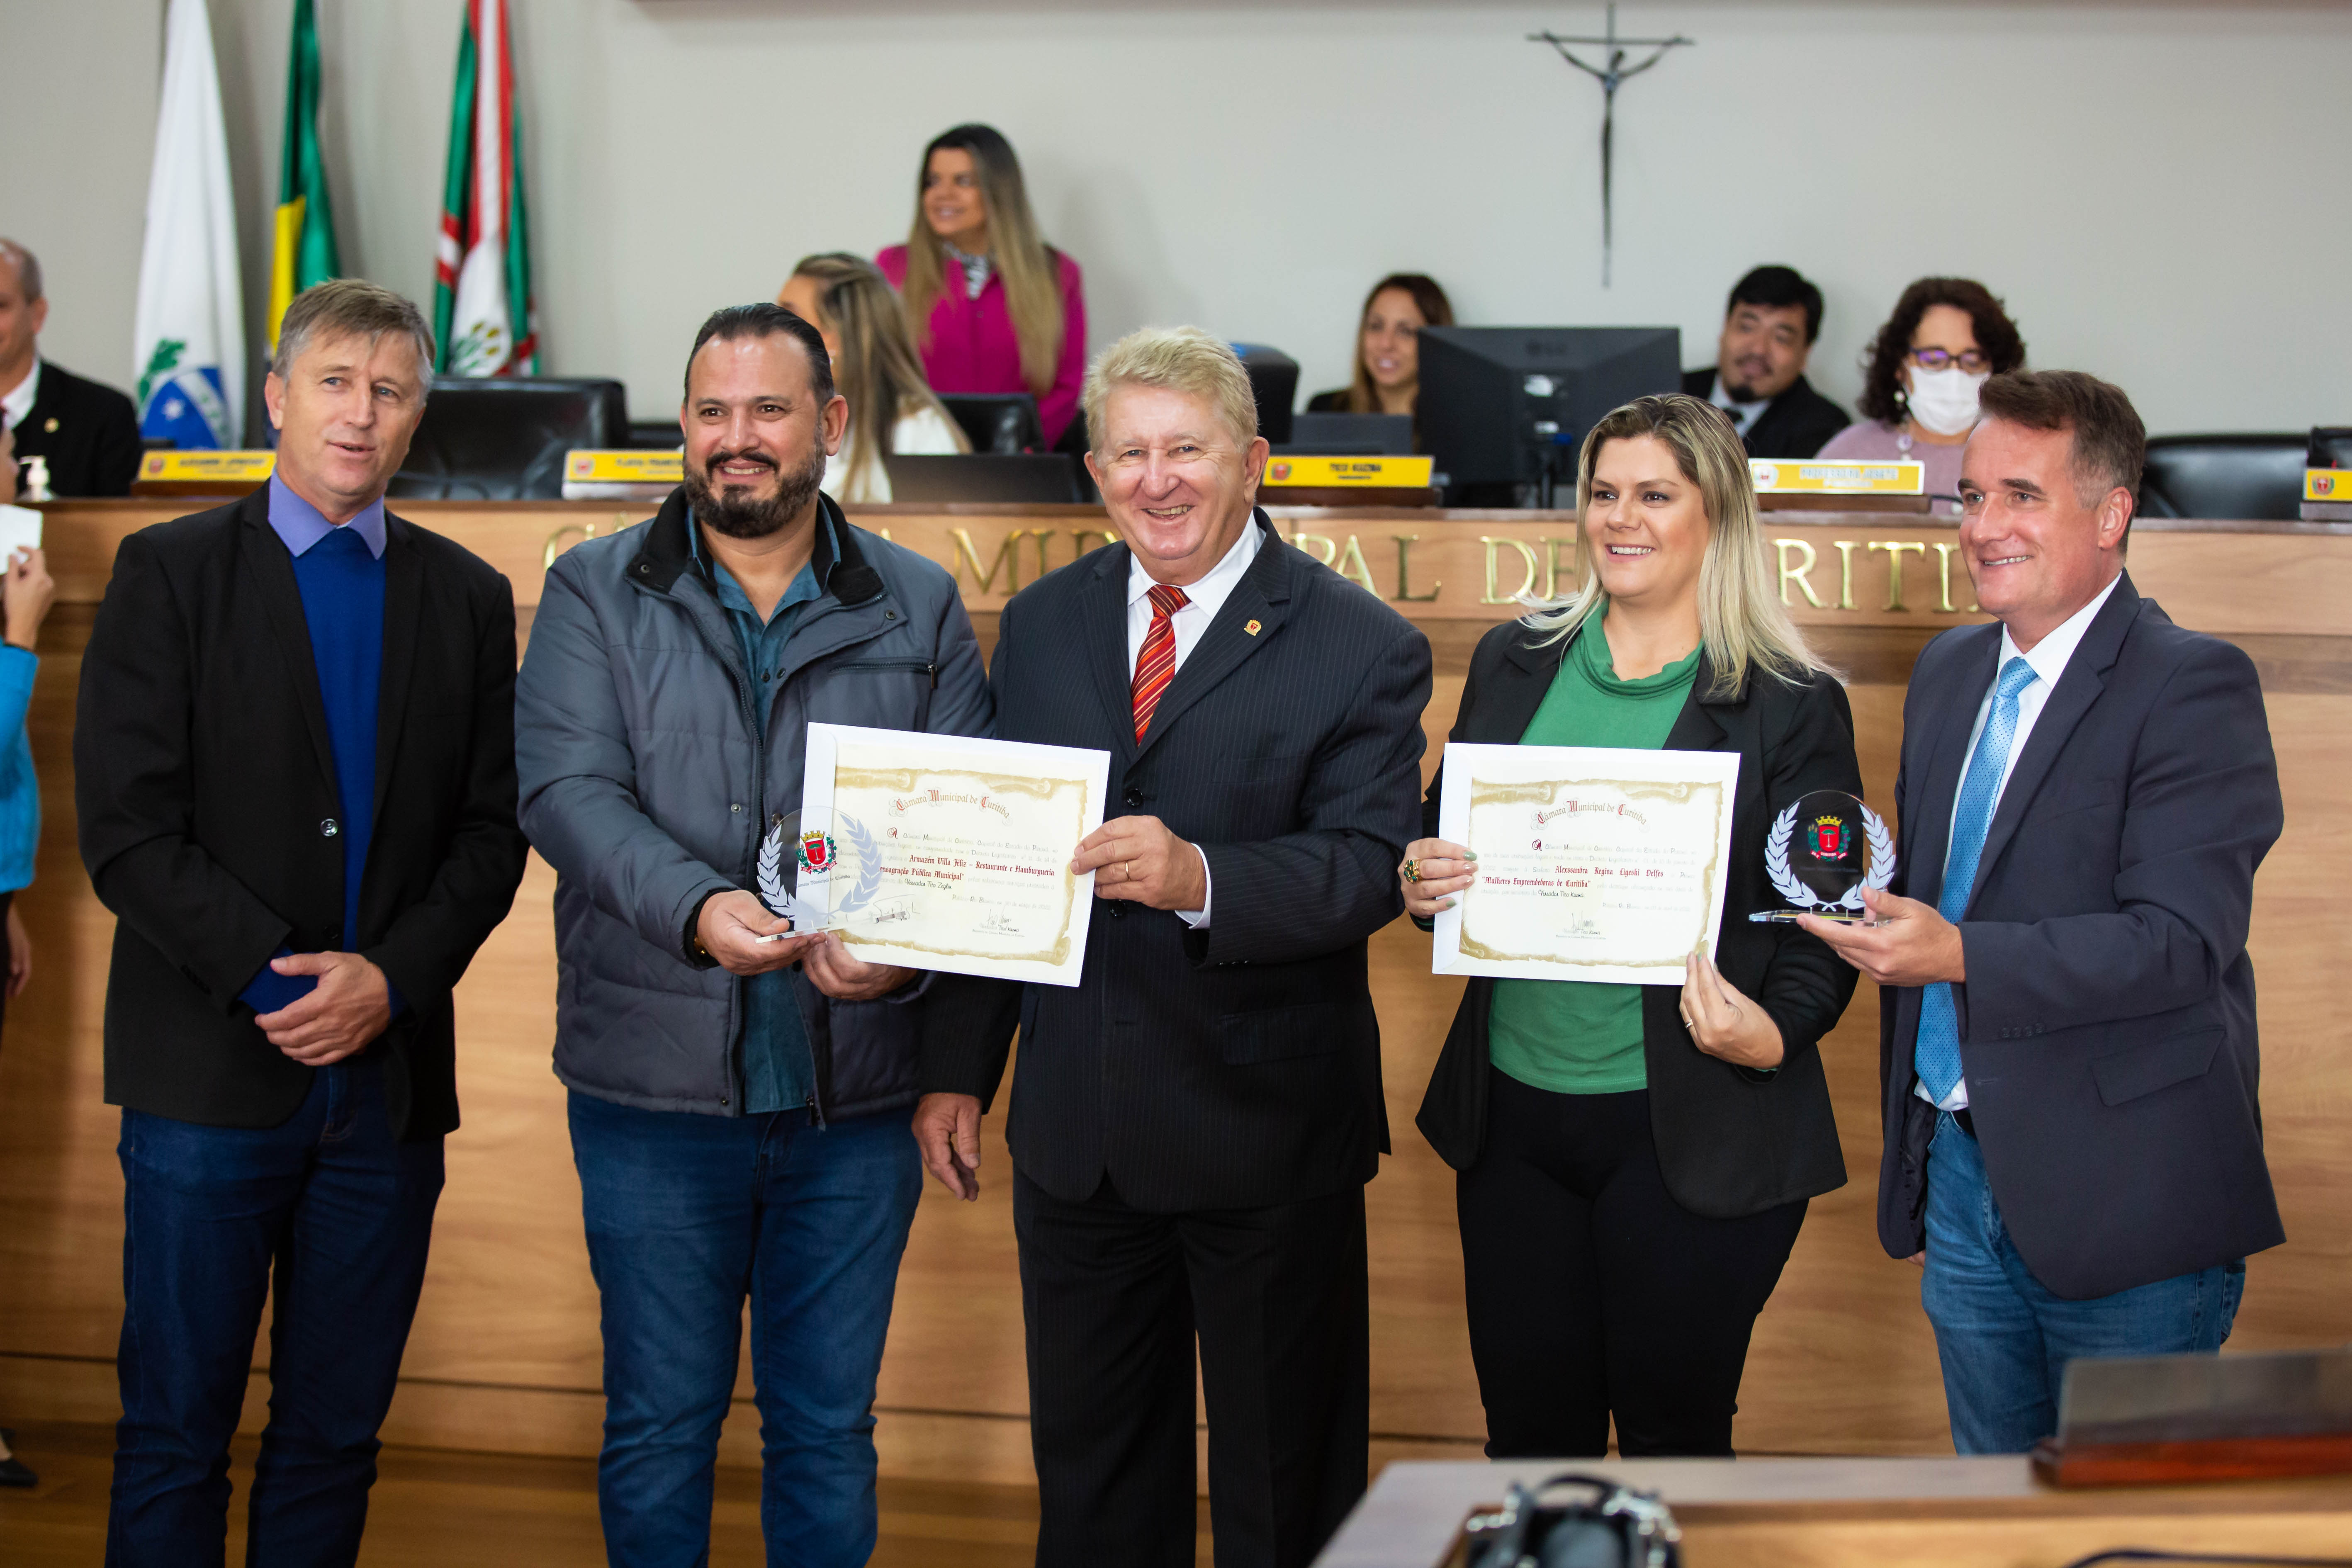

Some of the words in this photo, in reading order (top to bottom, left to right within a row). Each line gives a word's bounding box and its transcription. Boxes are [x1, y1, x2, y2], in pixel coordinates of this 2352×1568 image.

[895, 795, 927, 812] Câmara
[927, 790, 968, 803] Municipal
[969, 795, 978, 804] de
[980, 796, 1010, 819] Curitiba
[1537, 807, 1566, 824] Câmara
[1566, 800, 1605, 813] Municipal
[1606, 802, 1614, 812] de
[1617, 803, 1646, 826] Curitiba
[909, 854, 935, 864] Armazém
[937, 857, 951, 865] Villa
[953, 859, 967, 867] Feliz
[975, 861, 1007, 872] Restaurante
[1014, 865, 1055, 877] Hamburgueria
[911, 868, 931, 877] Pública
[1555, 865, 1588, 874] Alexssandra
[1594, 866, 1613, 878] Regina
[1619, 868, 1639, 878] Ligeski
[1646, 869, 1664, 879] Delfes
[1513, 878, 1554, 888] Empreendedoras
[1557, 879, 1563, 887] de
